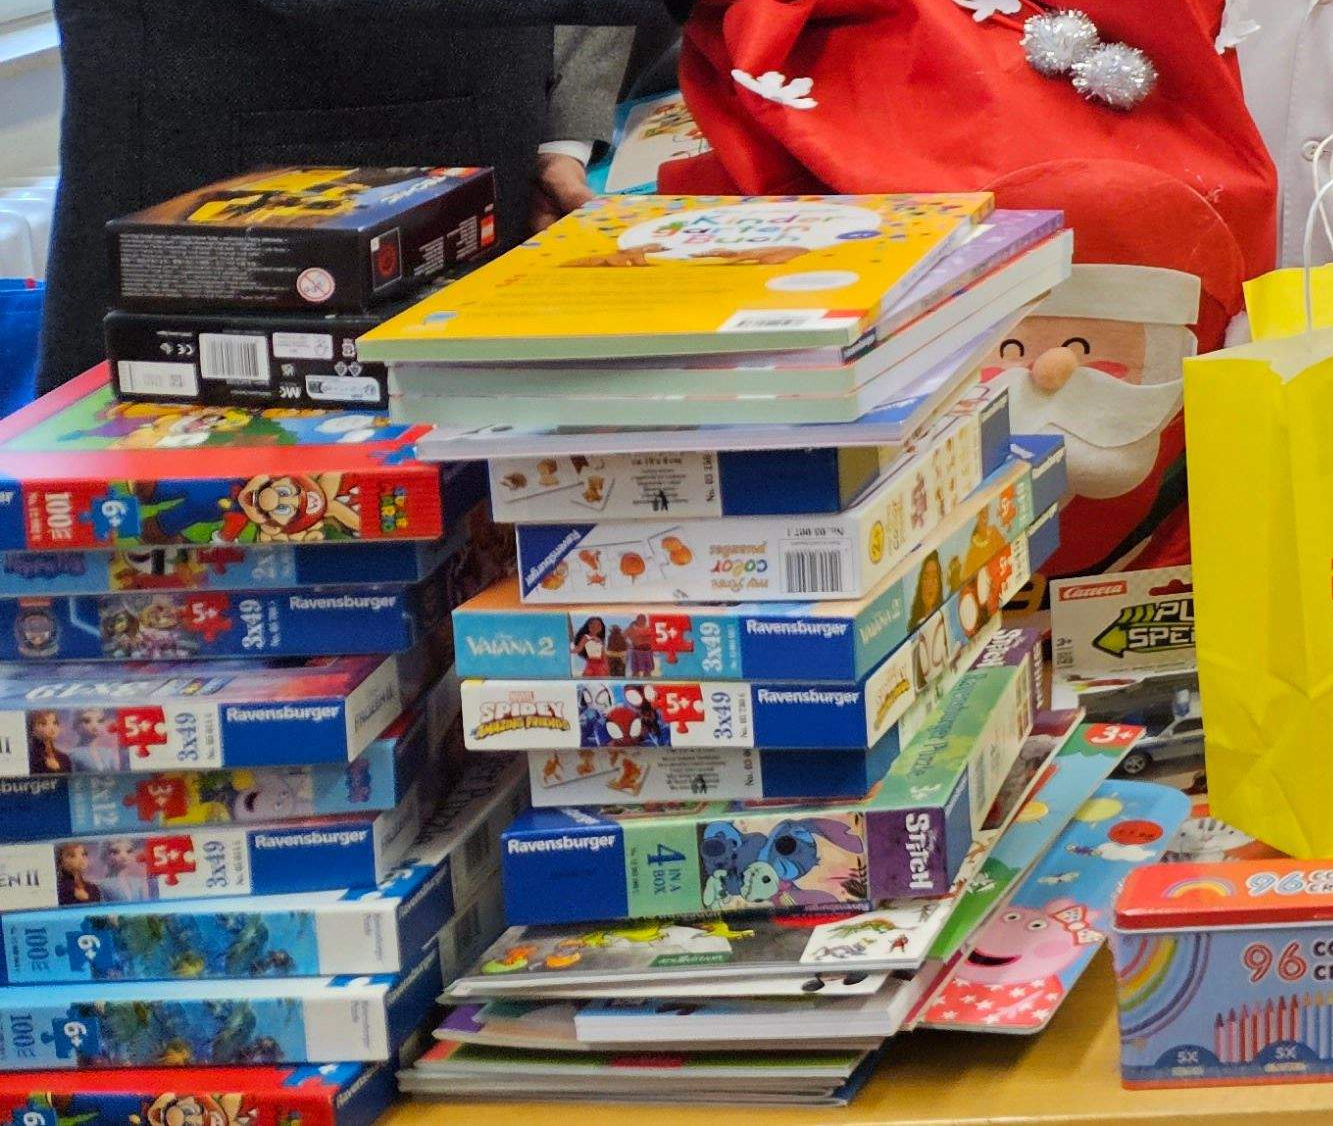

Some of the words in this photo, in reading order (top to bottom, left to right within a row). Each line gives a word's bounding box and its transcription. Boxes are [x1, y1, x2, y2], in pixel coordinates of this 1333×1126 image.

[692, 210, 836, 228] Kinder
[690, 231, 800, 245] Buch
[524, 529, 582, 586] Ravensburger
[710, 558, 769, 575] color
[289, 594, 397, 611] Ravensburger
[1062, 583, 1124, 600] Carrera
[191, 602, 218, 624] 5+
[239, 598, 267, 651] 3x49
[654, 623, 679, 644] 5+
[746, 618, 849, 641] Ravensburger
[1128, 627, 1196, 649] SPE
[699, 622, 723, 674] 3x49
[666, 693, 691, 715] 5+
[756, 687, 860, 707] Ravensburger
[226, 704, 341, 723] Ravensburger
[479, 699, 568, 723] SPIDEY
[712, 691, 734, 740] 3x49
[174, 711, 200, 763] 3x49
[1093, 723, 1136, 747] 3+
[0, 776, 58, 795] burger
[254, 828, 368, 850] Ravensburger
[507, 831, 615, 856] Ravensburger
[202, 840, 229, 889] 3x49
[648, 843, 687, 867] 4
[1245, 870, 1304, 895] 96
[76, 933, 102, 962] 6+
[1243, 941, 1308, 983] 96
[63, 1020, 88, 1050] 6+
